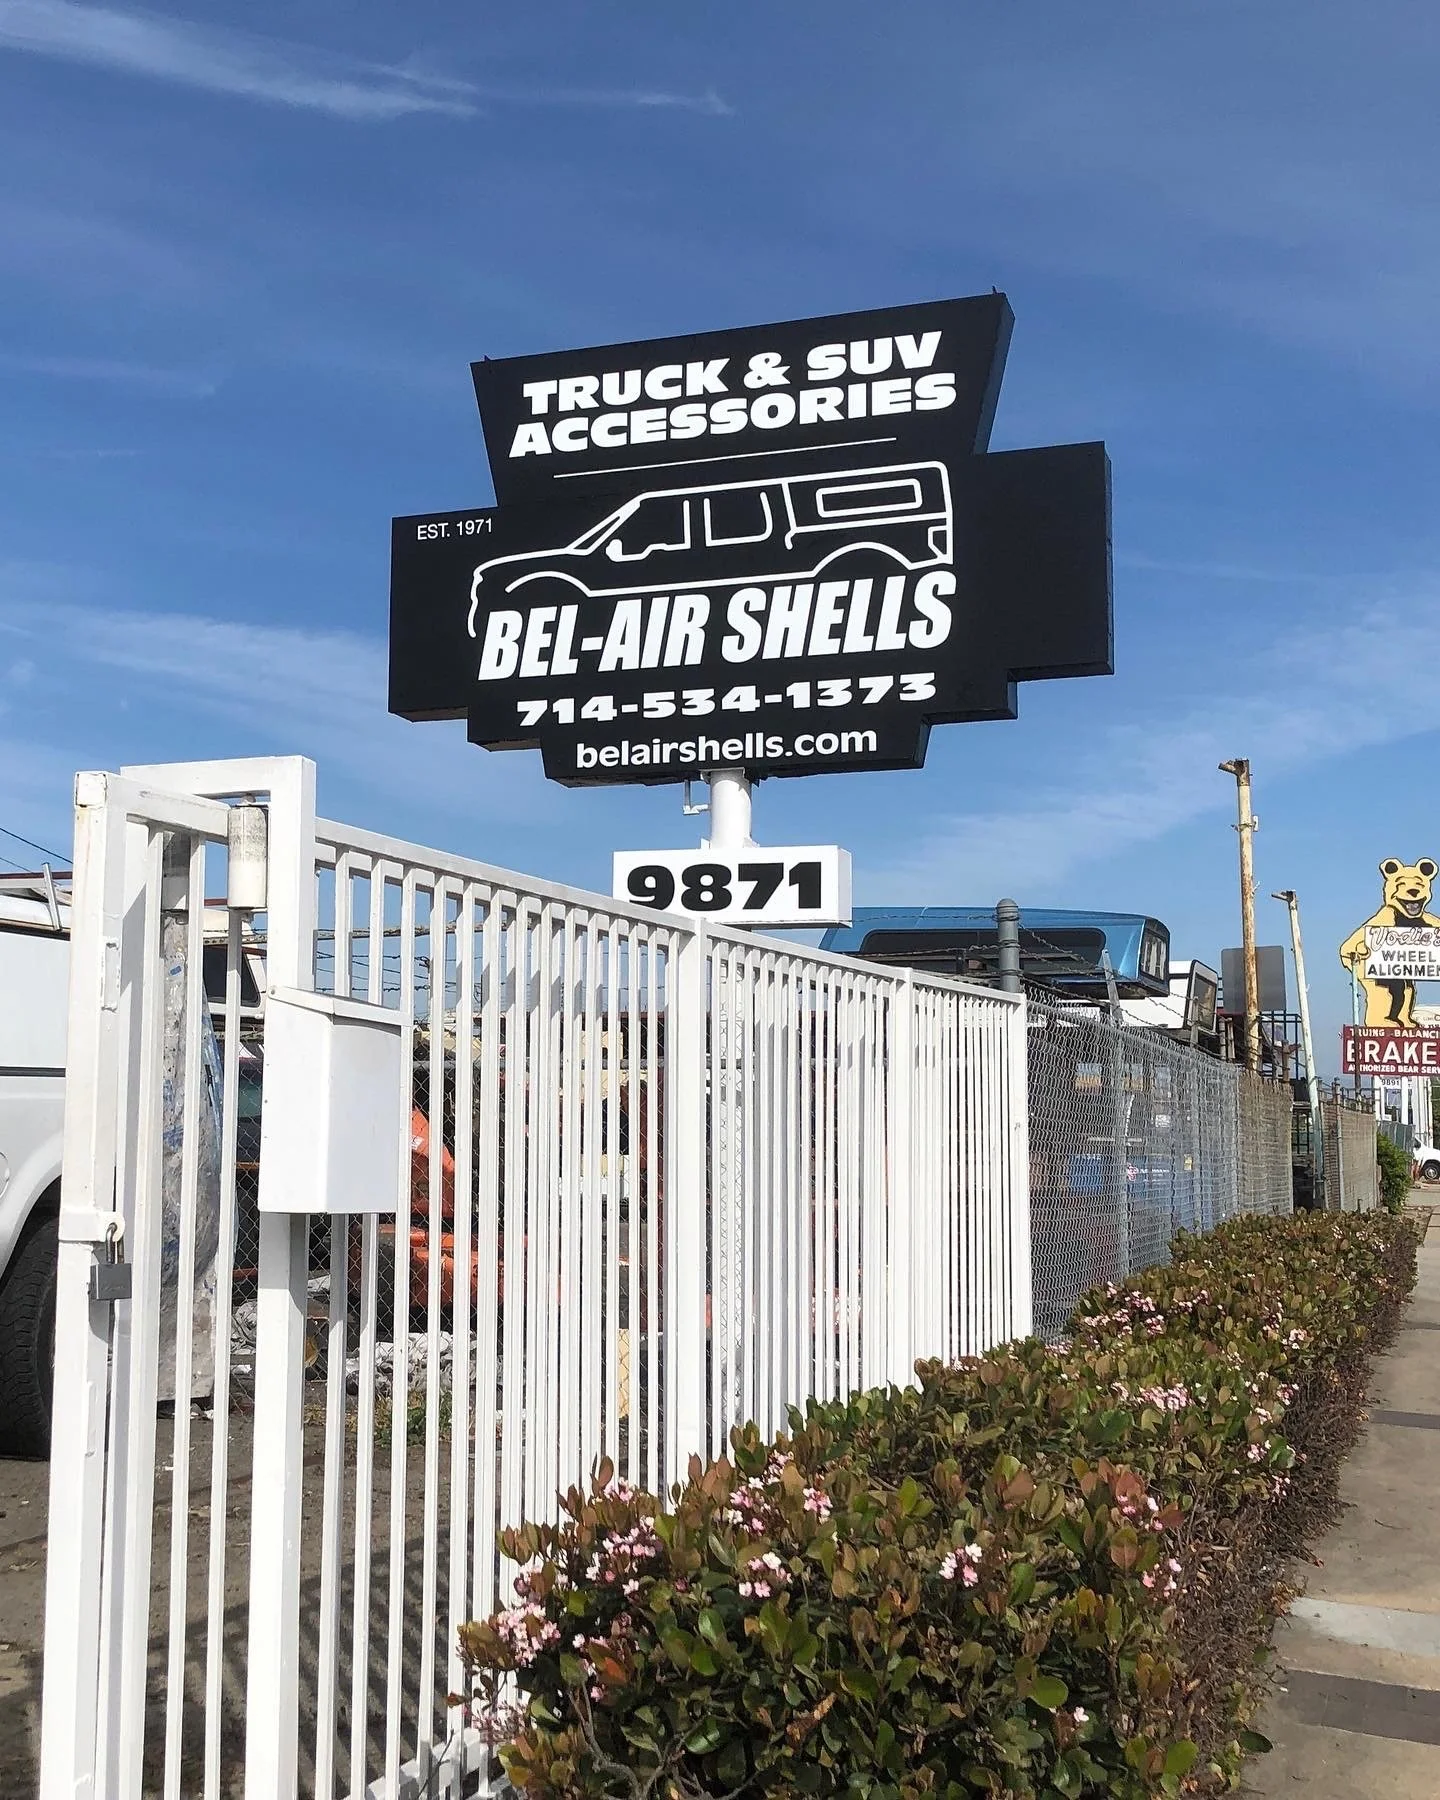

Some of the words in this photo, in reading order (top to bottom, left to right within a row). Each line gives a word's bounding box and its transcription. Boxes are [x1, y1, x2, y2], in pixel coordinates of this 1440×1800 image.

[522, 358, 731, 415] TRUCK
[743, 351, 791, 389] &
[806, 330, 942, 381] SUV
[508, 372, 957, 458] ACCESSORIES
[417, 522, 450, 540] EST.
[456, 517, 492, 536] 1971
[477, 593, 711, 681] BEL-AIR
[721, 570, 957, 663] SHELLS
[516, 672, 937, 727] 714-534-1373
[576, 729, 877, 769] belairshells.com
[627, 861, 822, 912] 9871
[1381, 950, 1437, 962] WHEEL
[1348, 1064, 1396, 1073] ATHORIZED
[1397, 1065, 1420, 1073] BEAR
